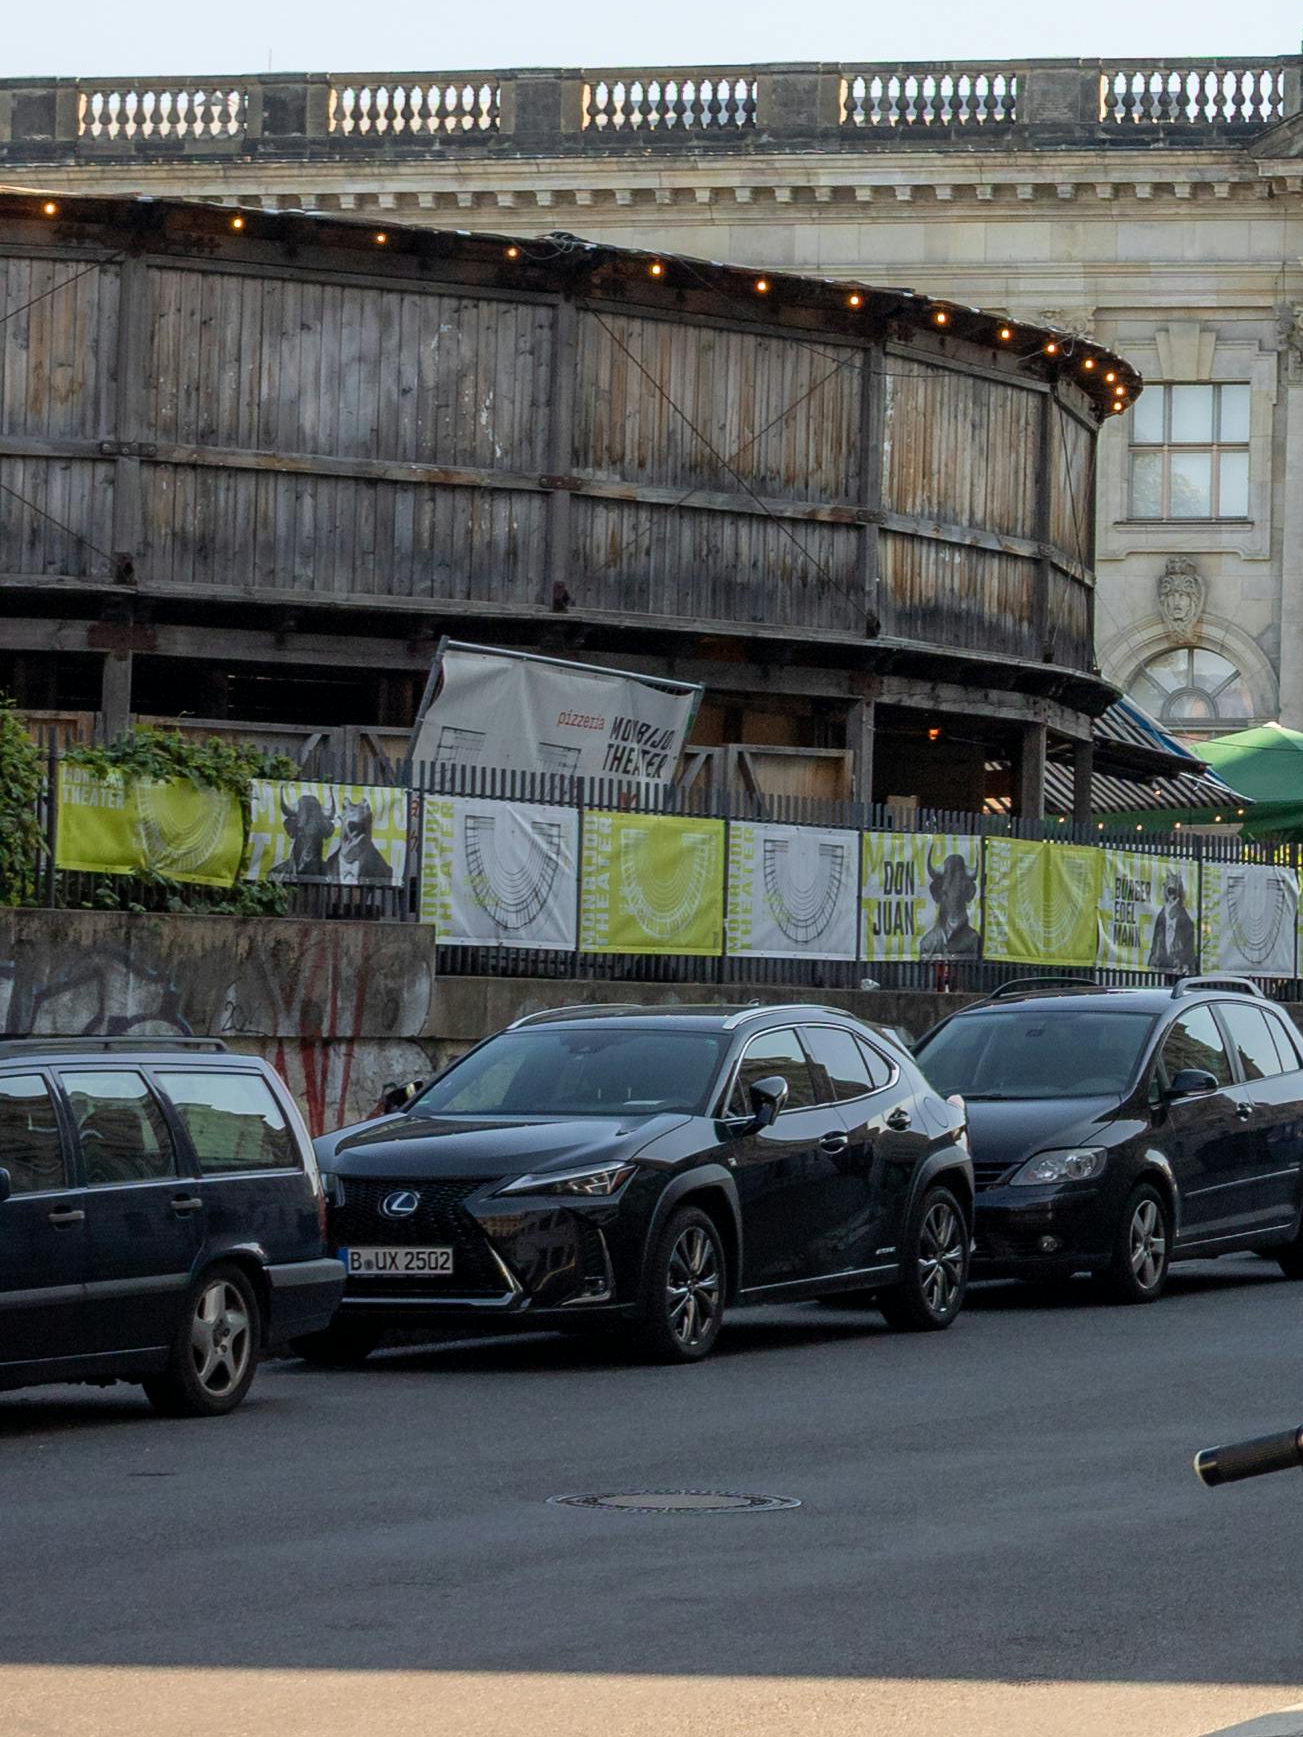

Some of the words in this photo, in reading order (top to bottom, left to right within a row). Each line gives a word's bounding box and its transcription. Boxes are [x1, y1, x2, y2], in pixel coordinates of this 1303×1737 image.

[557, 710, 605, 730] pizzeria
[610, 716, 676, 751] MONBIJO
[602, 743, 669, 779] THEATER
[63, 783, 124, 810] THEATER
[422, 800, 440, 915] ONBIJOU
[438, 802, 454, 936] THEATER
[582, 815, 598, 950] MONBIJOU
[596, 817, 612, 946] THEATER
[728, 825, 742, 953] MONBIJOU
[740, 828, 755, 951] THEATER
[884, 861, 915, 895] DON
[873, 901, 914, 936] JUAN
[1115, 901, 1136, 924] EDEL
[1114, 924, 1140, 948] MANN
[350, 1251, 362, 1271] B
[375, 1251, 399, 1271] UX
[404, 1251, 451, 1271] 2502
